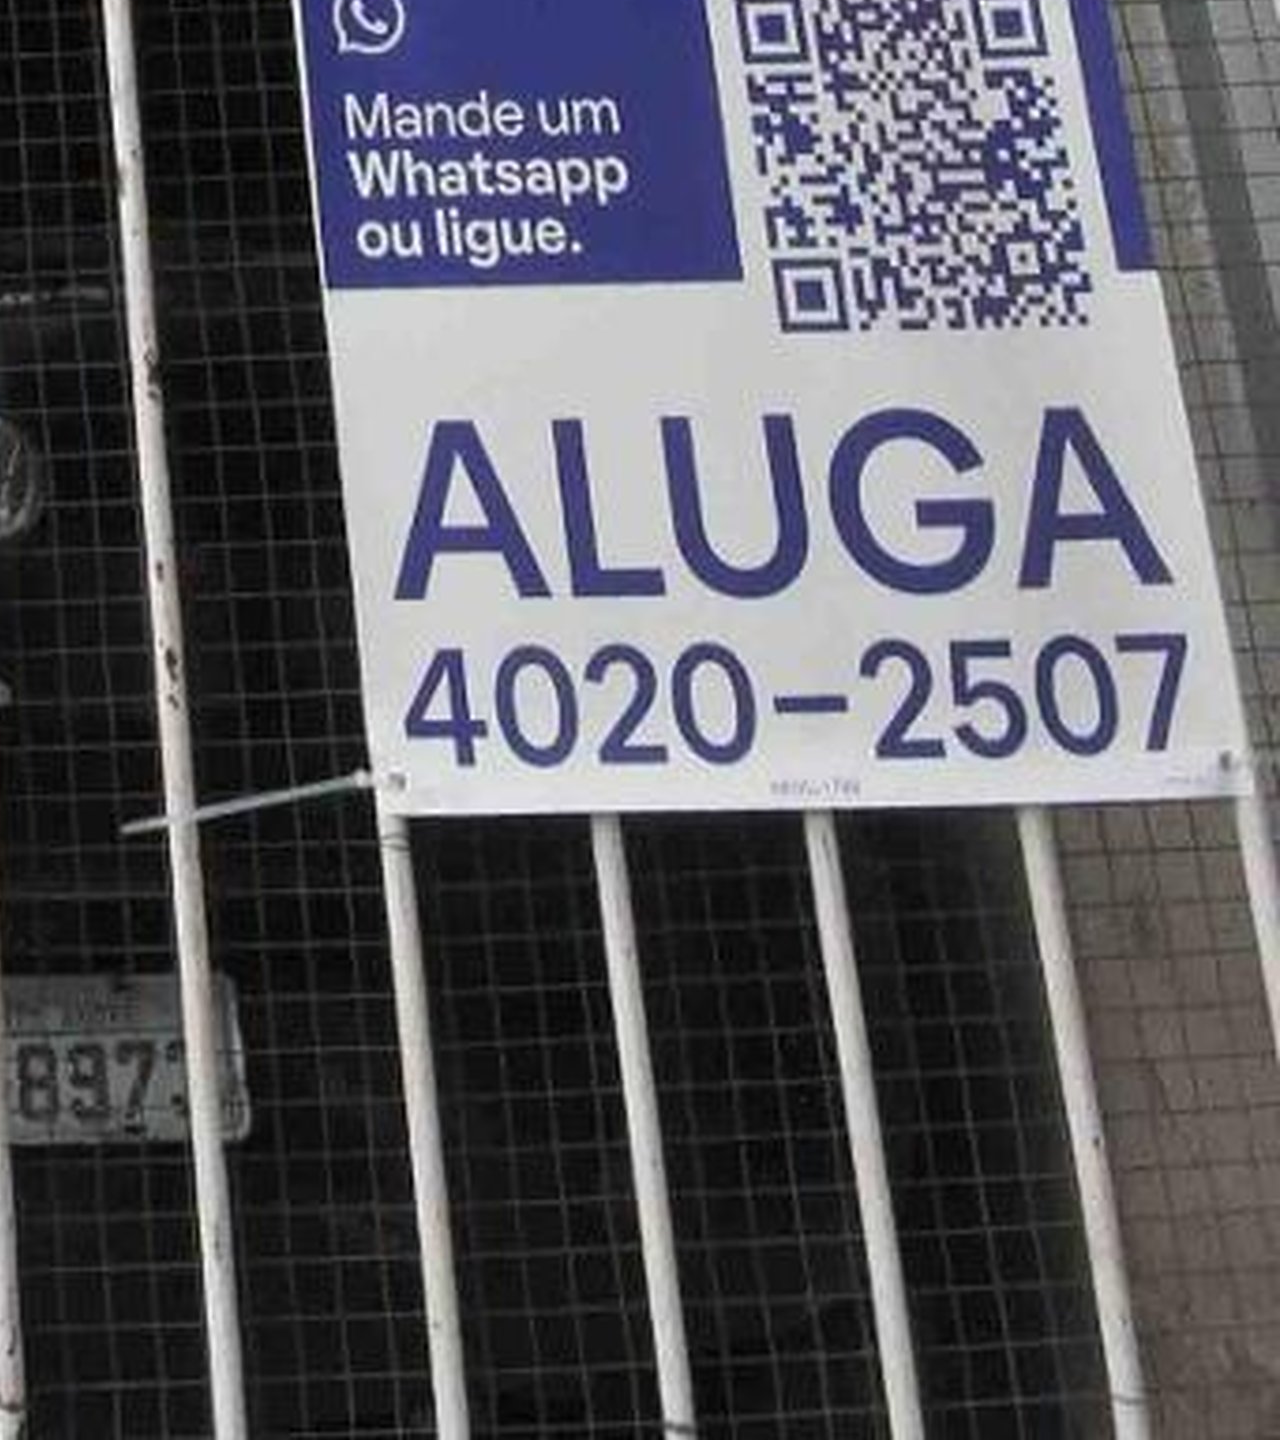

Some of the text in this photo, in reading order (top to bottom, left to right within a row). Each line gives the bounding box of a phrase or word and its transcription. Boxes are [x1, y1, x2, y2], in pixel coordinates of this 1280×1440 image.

[343, 88, 623, 141] Mande um
[345, 148, 630, 207] Whatsapp
[355, 206, 584, 268] ou ligue.
[394, 405, 1175, 600] ALUGA
[404, 632, 1190, 768] 4020-2507
